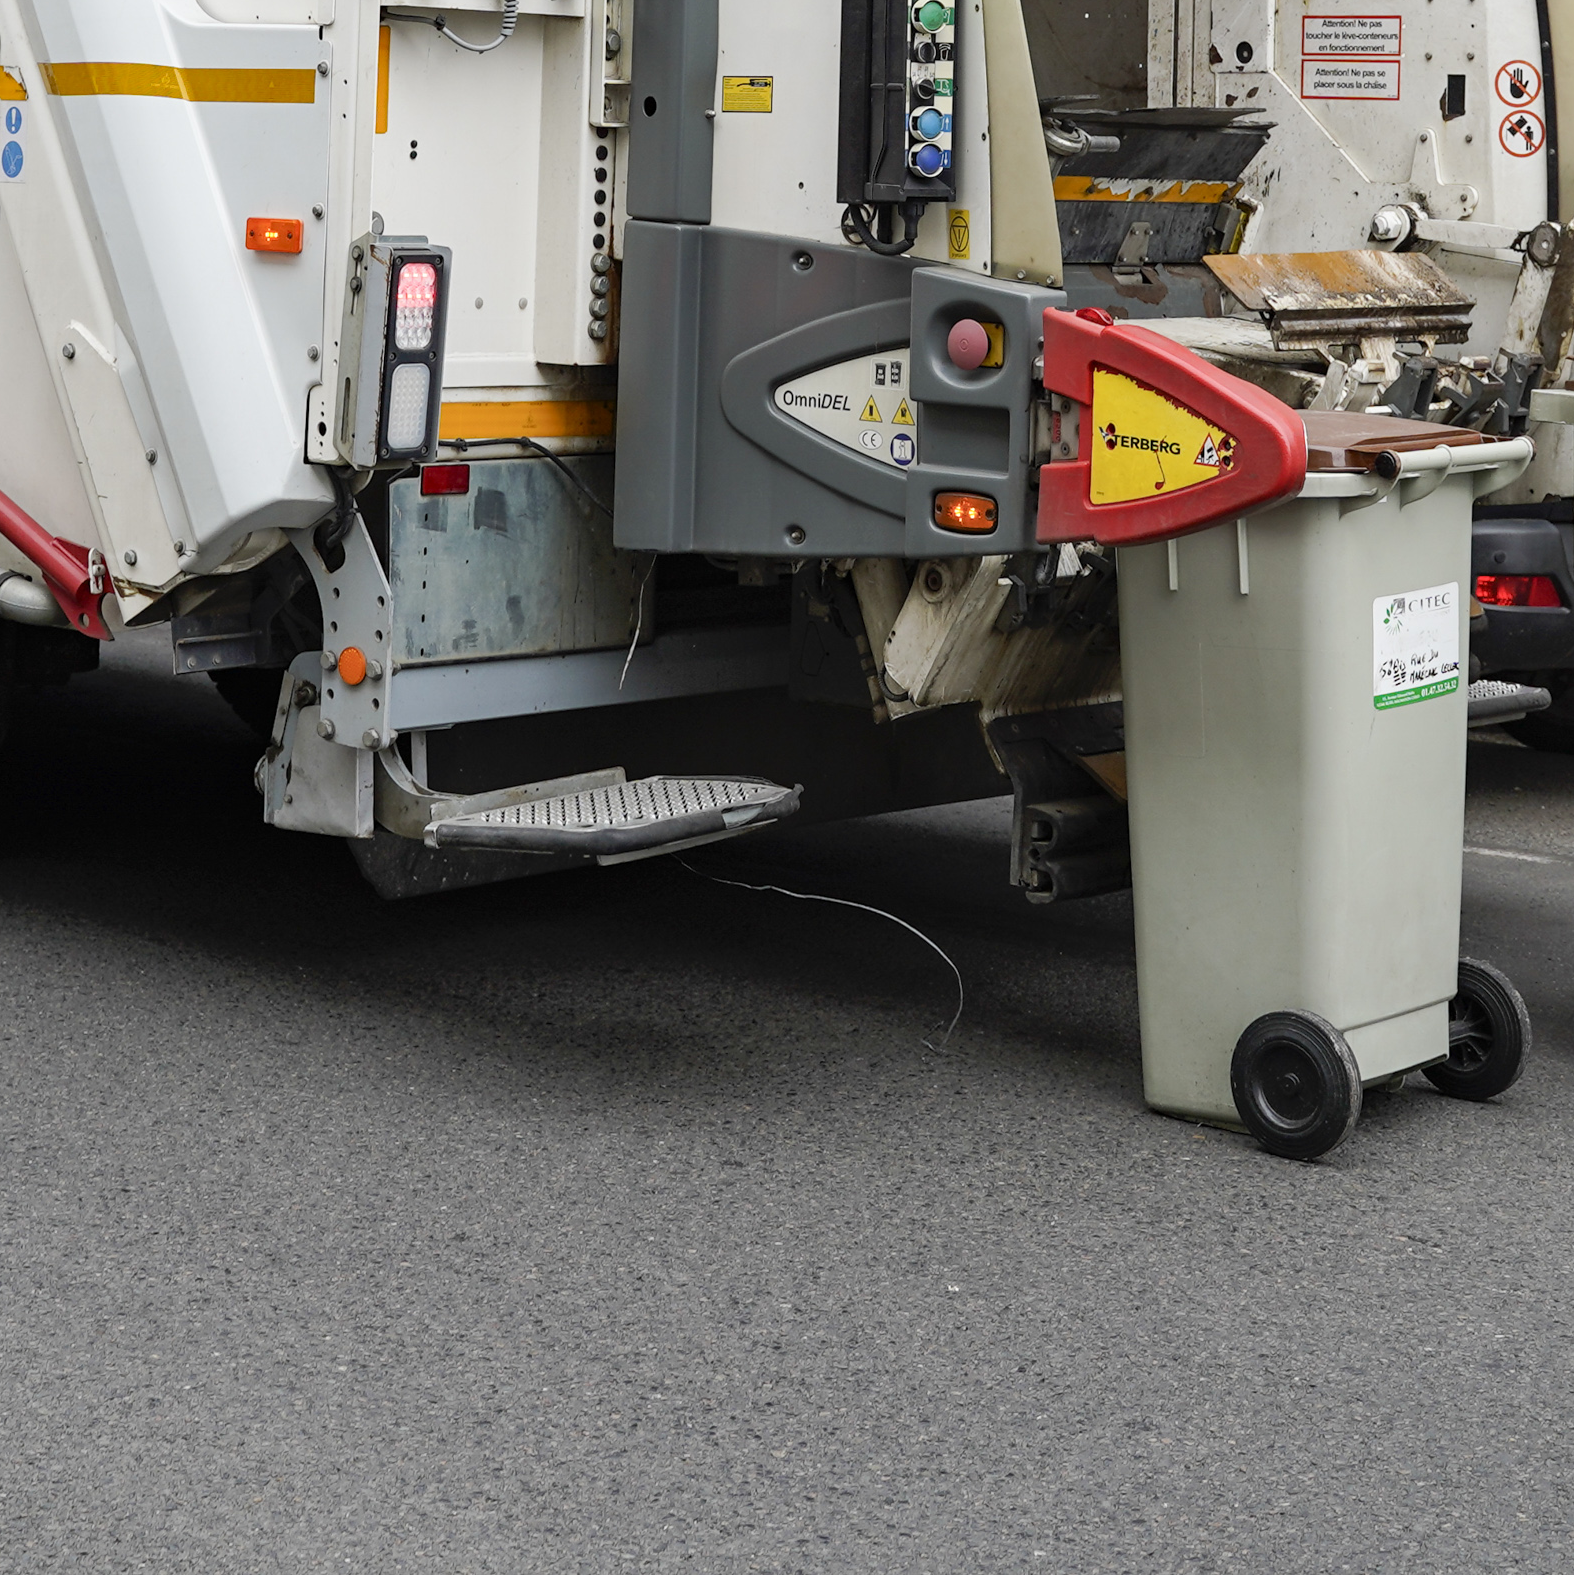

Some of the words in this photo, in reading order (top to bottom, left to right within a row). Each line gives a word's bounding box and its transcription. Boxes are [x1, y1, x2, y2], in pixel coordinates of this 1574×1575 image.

[1321, 19, 1357, 28] Attention!
[1357, 19, 1368, 27] Ne
[1369, 20, 1383, 29] pas
[1305, 31, 1333, 40] toucher
[1334, 31, 1341, 40] le
[1341, 31, 1399, 40] lève-conteneurs
[1328, 43, 1386, 52] fonctionnement
[1315, 67, 1350, 77] Attention!
[1350, 68, 1362, 77] Ne
[1362, 70, 1376, 79] pas
[1377, 70, 1386, 78] se
[1313, 80, 1336, 90] placer
[1336, 81, 1355, 89] sous
[1355, 80, 1362, 89] la
[783, 389, 852, 413] OmniDEL
[1112, 434, 1181, 456] TERBERG
[1408, 591, 1451, 613] CITEC
